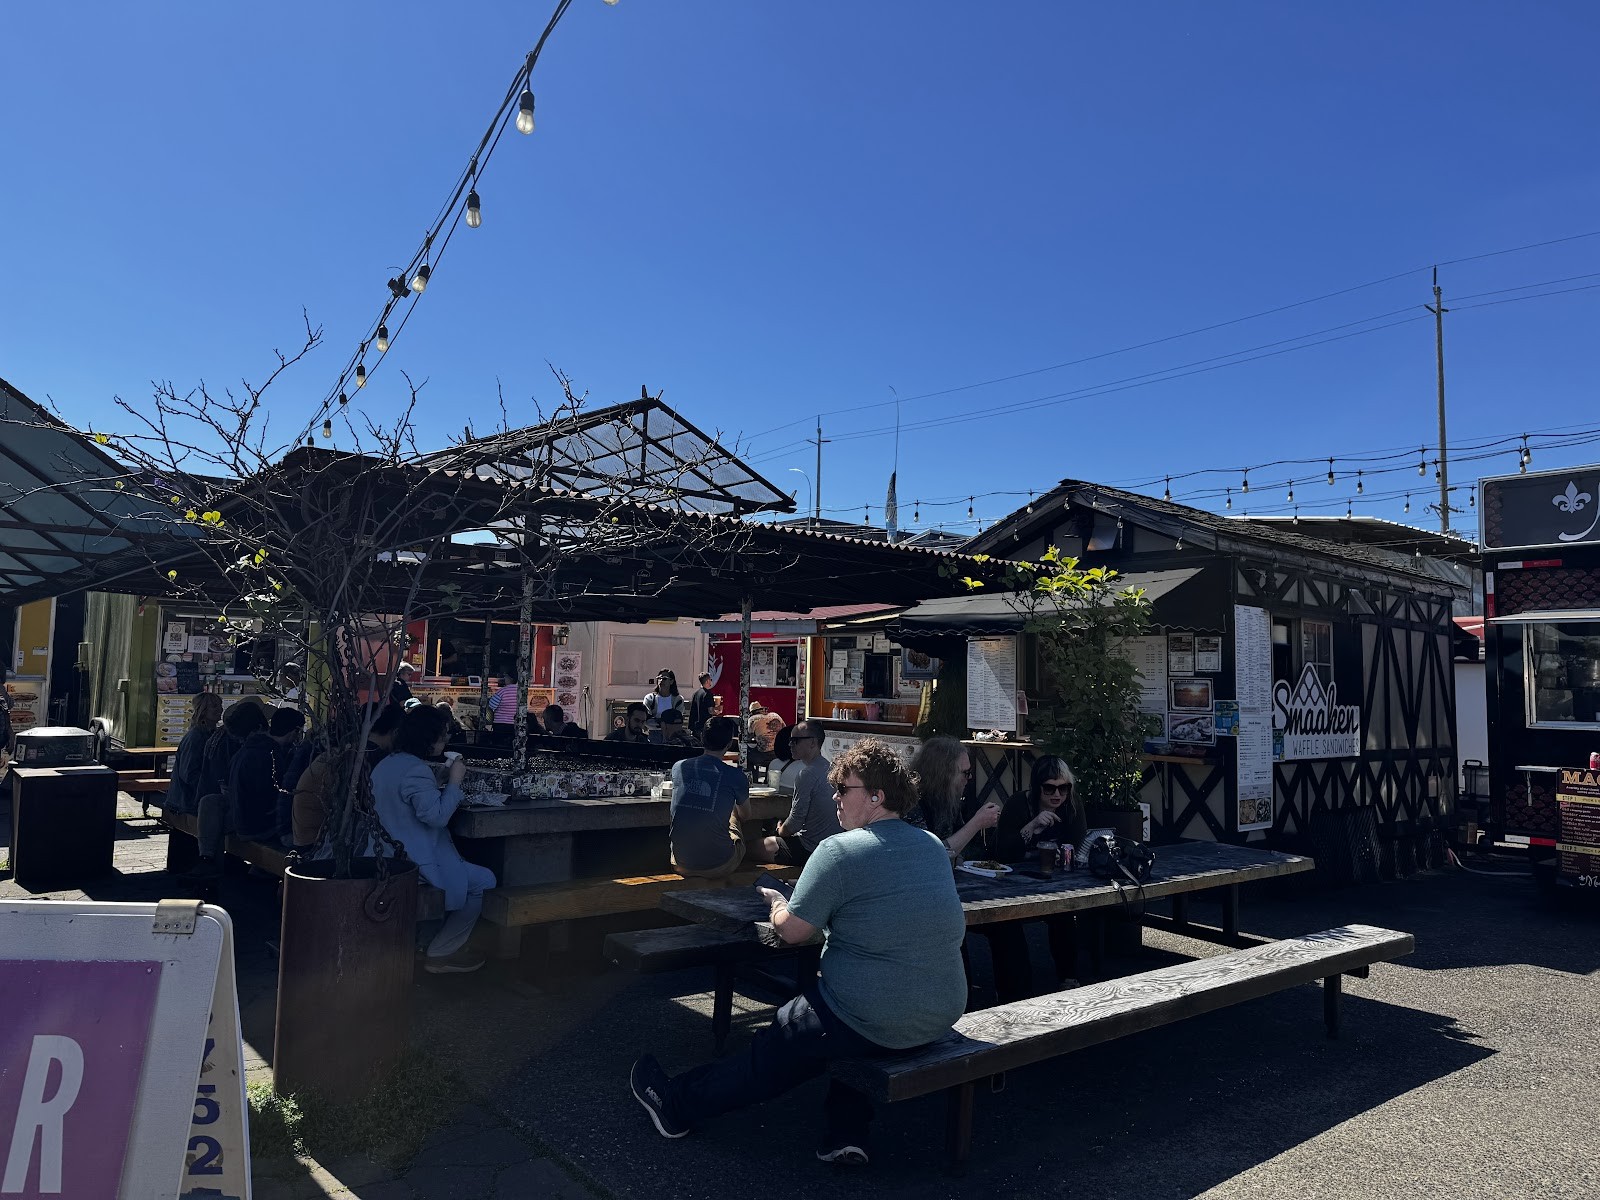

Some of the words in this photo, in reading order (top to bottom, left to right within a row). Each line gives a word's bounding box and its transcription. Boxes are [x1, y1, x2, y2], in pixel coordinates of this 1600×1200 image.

[1274, 682, 1359, 736] Smaaken
[1292, 739, 1321, 756] WAFFLE
[1322, 738, 1360, 756] SANDWICHES
[1561, 770, 1600, 787] MA
[1, 1034, 85, 1194] R
